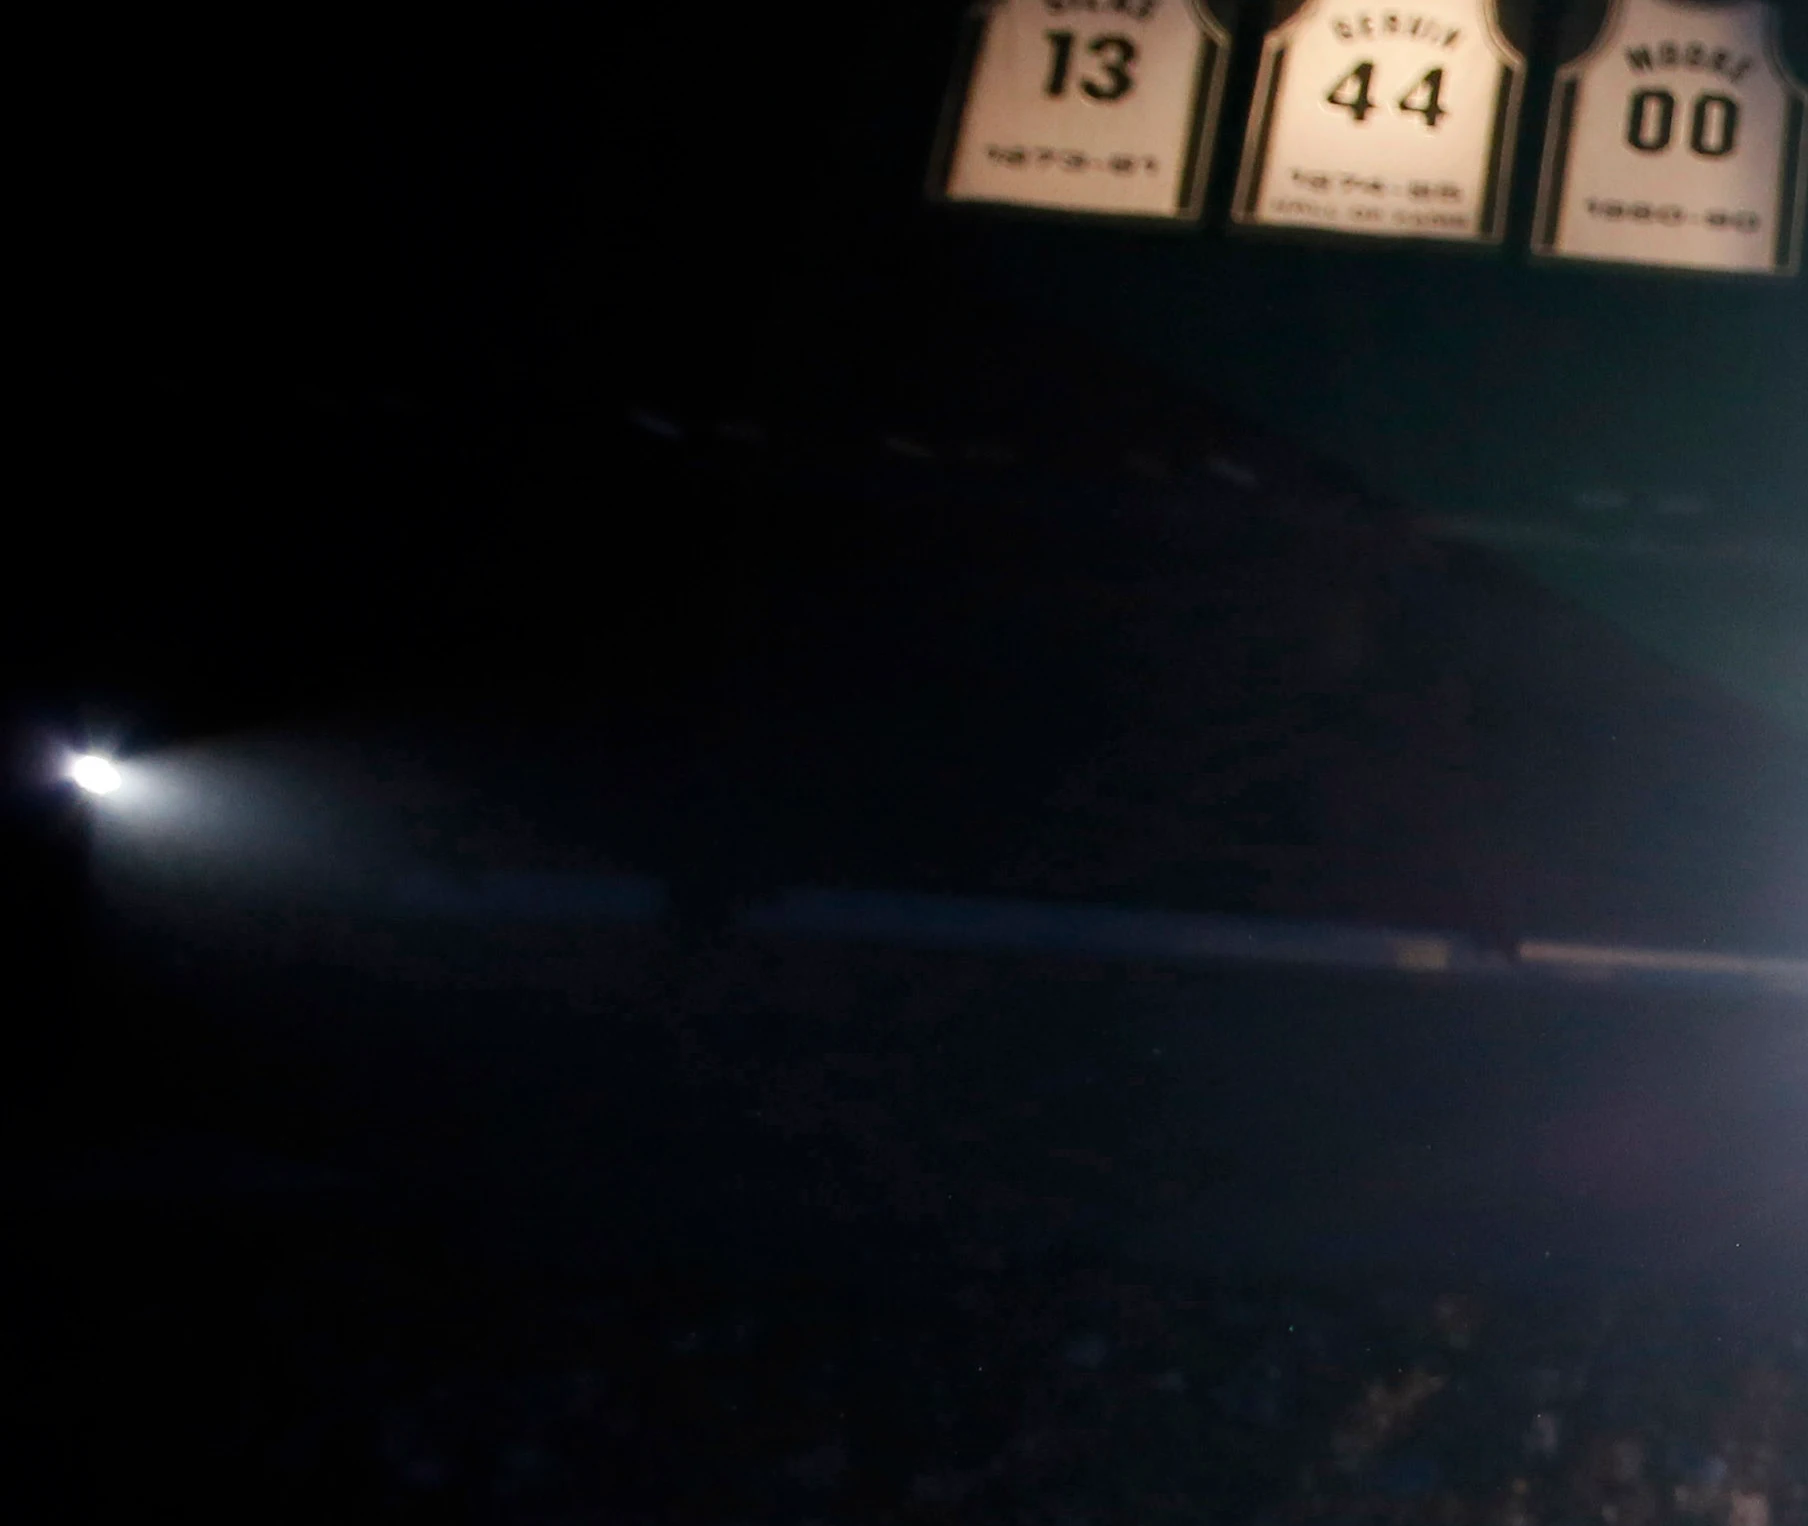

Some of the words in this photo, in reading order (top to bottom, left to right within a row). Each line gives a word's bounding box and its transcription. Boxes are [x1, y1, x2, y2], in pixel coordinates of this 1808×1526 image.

[1045, 29, 1136, 102] 13
[1327, 60, 1449, 126] 44
[1626, 88, 1737, 157] 00
